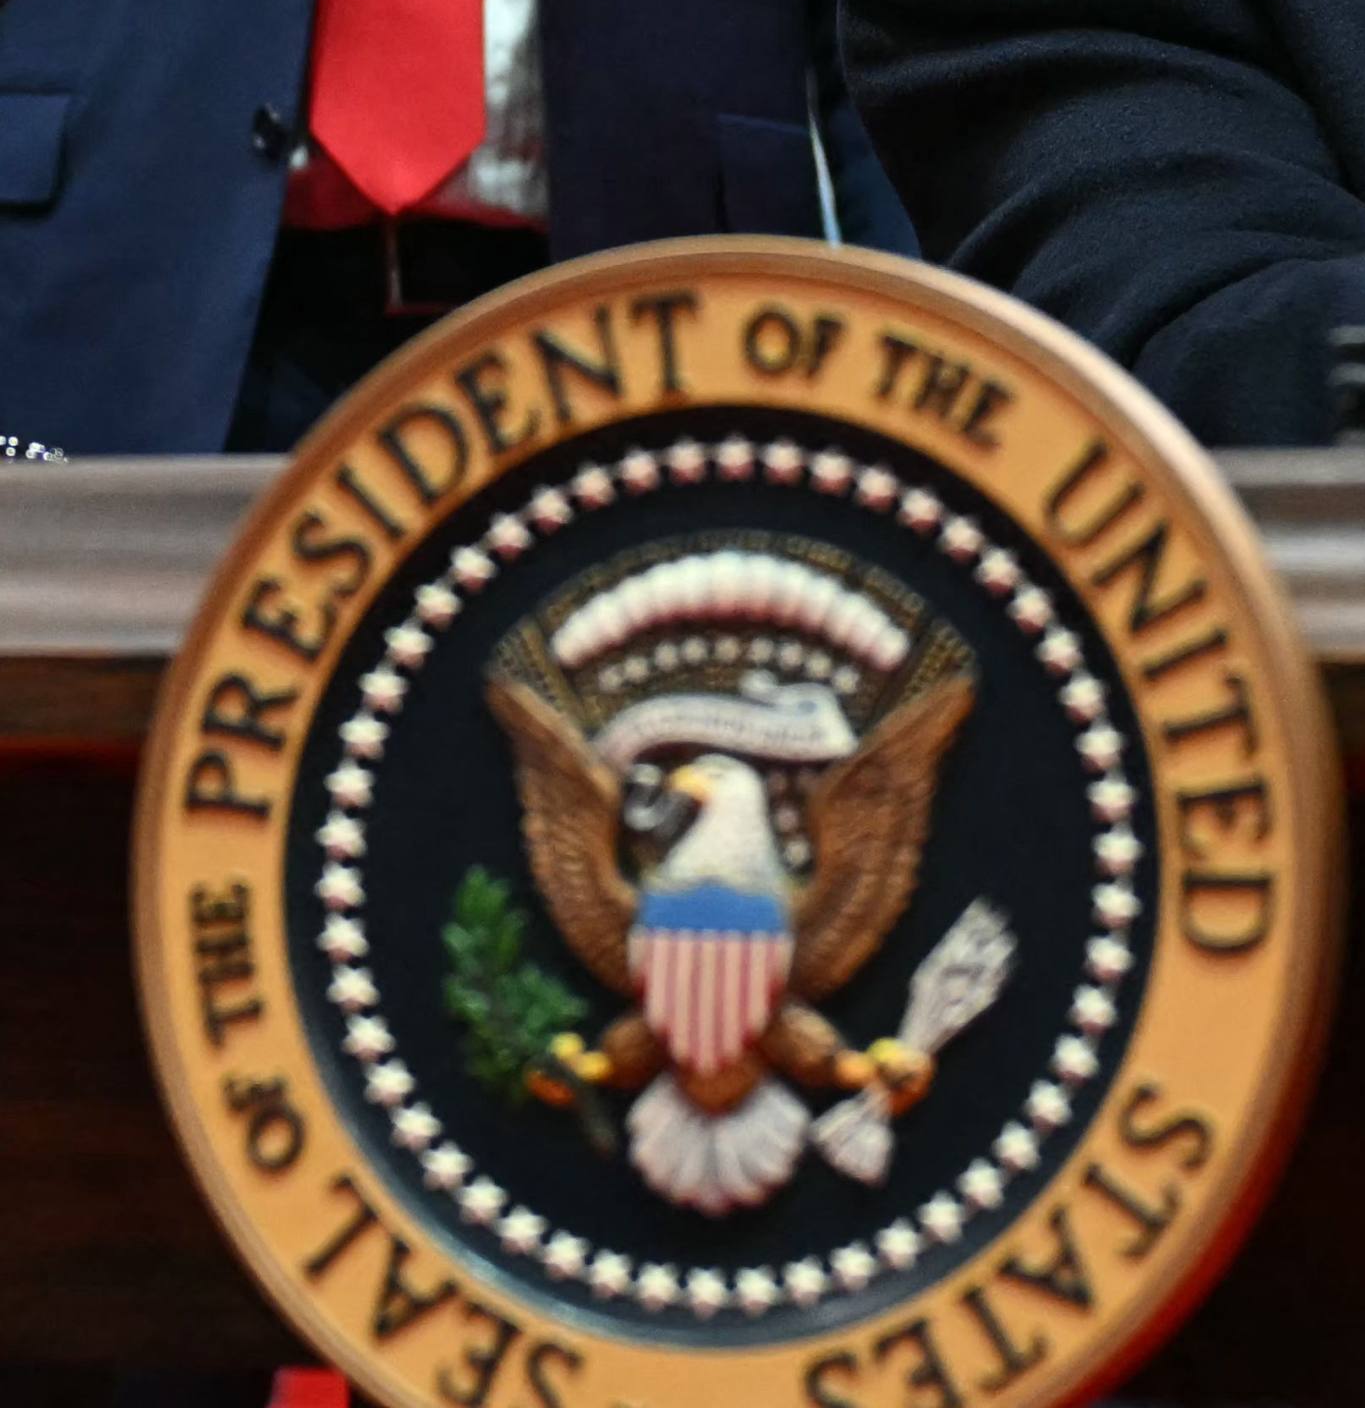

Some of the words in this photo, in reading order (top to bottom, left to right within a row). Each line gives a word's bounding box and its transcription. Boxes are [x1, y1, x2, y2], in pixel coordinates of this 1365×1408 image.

[743, 305, 845, 378] OF
[877, 332, 1015, 450] THE
[183, 291, 701, 820] PRESIDENT
[1046, 439, 1272, 954] UNITED
[190, 881, 264, 1047] THE
[221, 1075, 305, 1174] OF
